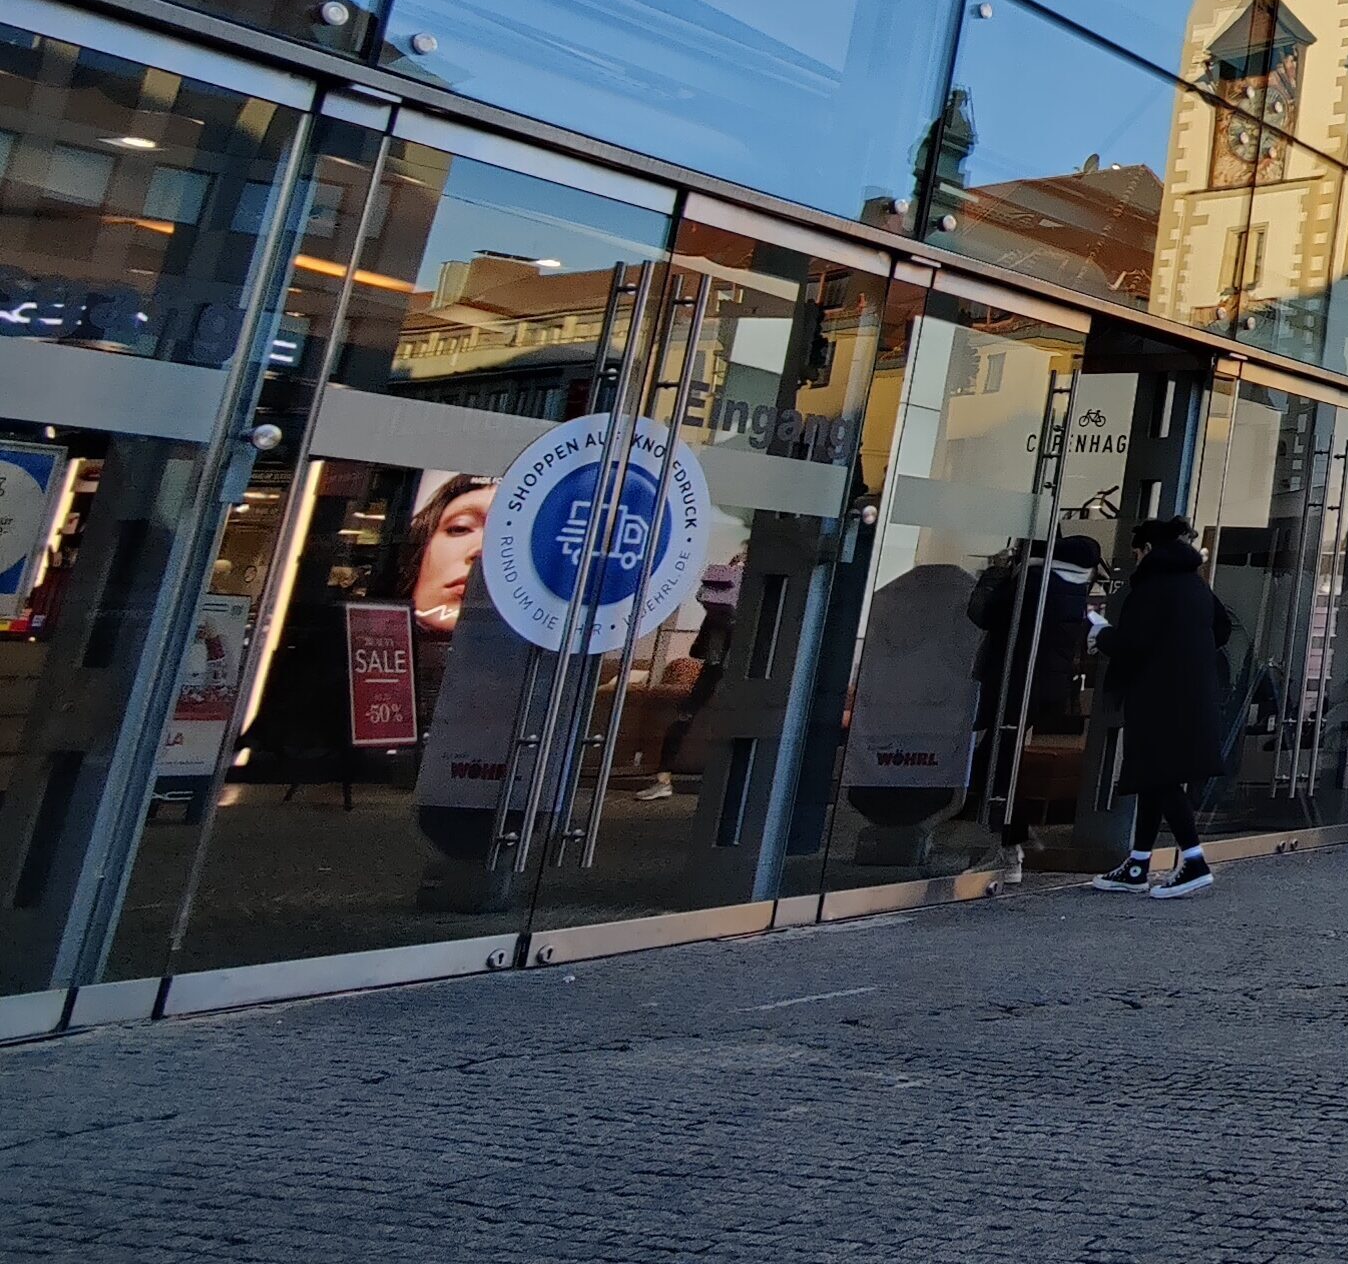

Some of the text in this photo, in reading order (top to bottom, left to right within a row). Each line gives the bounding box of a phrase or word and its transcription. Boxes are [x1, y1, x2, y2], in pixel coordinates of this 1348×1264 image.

[681, 379, 850, 463] Eingang
[508, 437, 579, 513] SHOPPEN
[500, 535, 518, 584] RUND
[512, 586, 534, 611] UM
[532, 607, 559, 631] DIE
[355, 649, 407, 674] SALE
[366, 703, 404, 724] -50%
